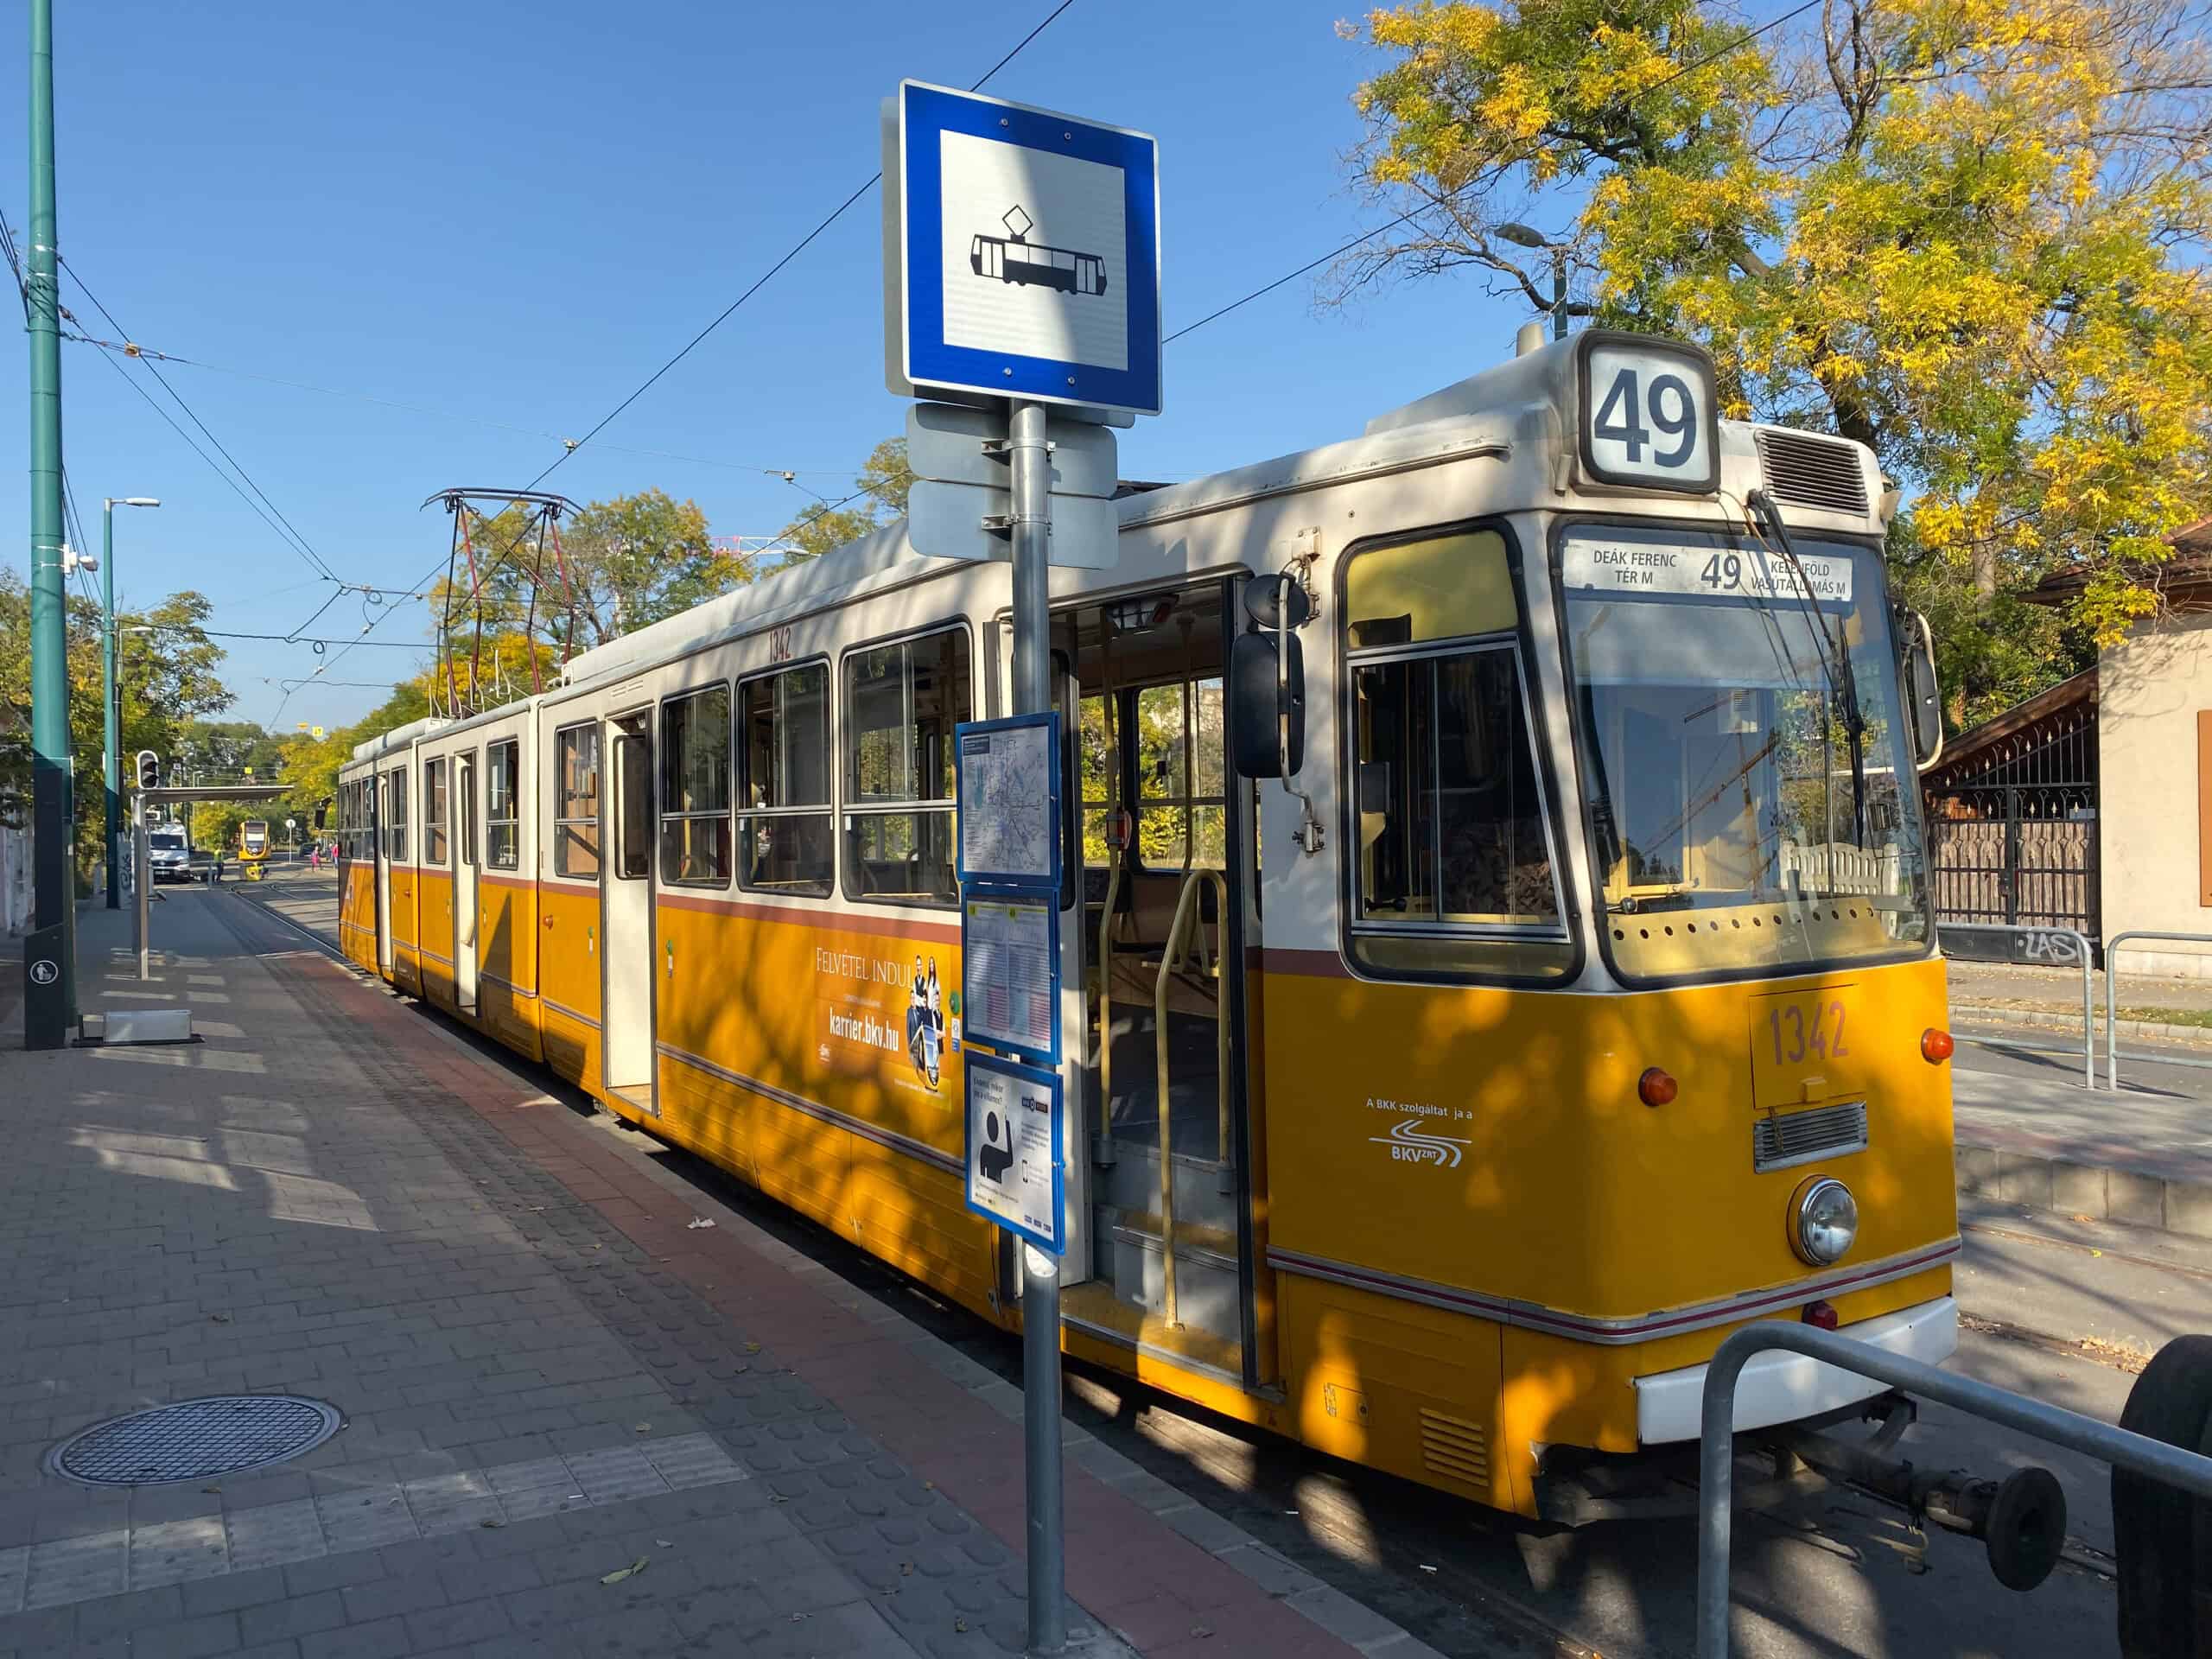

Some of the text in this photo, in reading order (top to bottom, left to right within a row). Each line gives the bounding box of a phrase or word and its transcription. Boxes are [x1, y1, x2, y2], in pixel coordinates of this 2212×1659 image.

[1593, 368, 1696, 467] 49
[1593, 548, 1678, 568] DEÁK FERENC
[1615, 567, 1653, 585] TÉR M
[1700, 553, 1742, 590] 49
[1836, 582, 1846, 595] M
[769, 627, 791, 664] 1342
[817, 947, 913, 988] FELVÉTEL INDUL
[830, 1007, 899, 1052] karrier.bkv.hu
[1770, 1001, 1849, 1065] 1342
[1366, 1098, 1374, 1108] A
[1376, 1098, 1397, 1111] BKK
[1465, 1110, 1473, 1120] a
